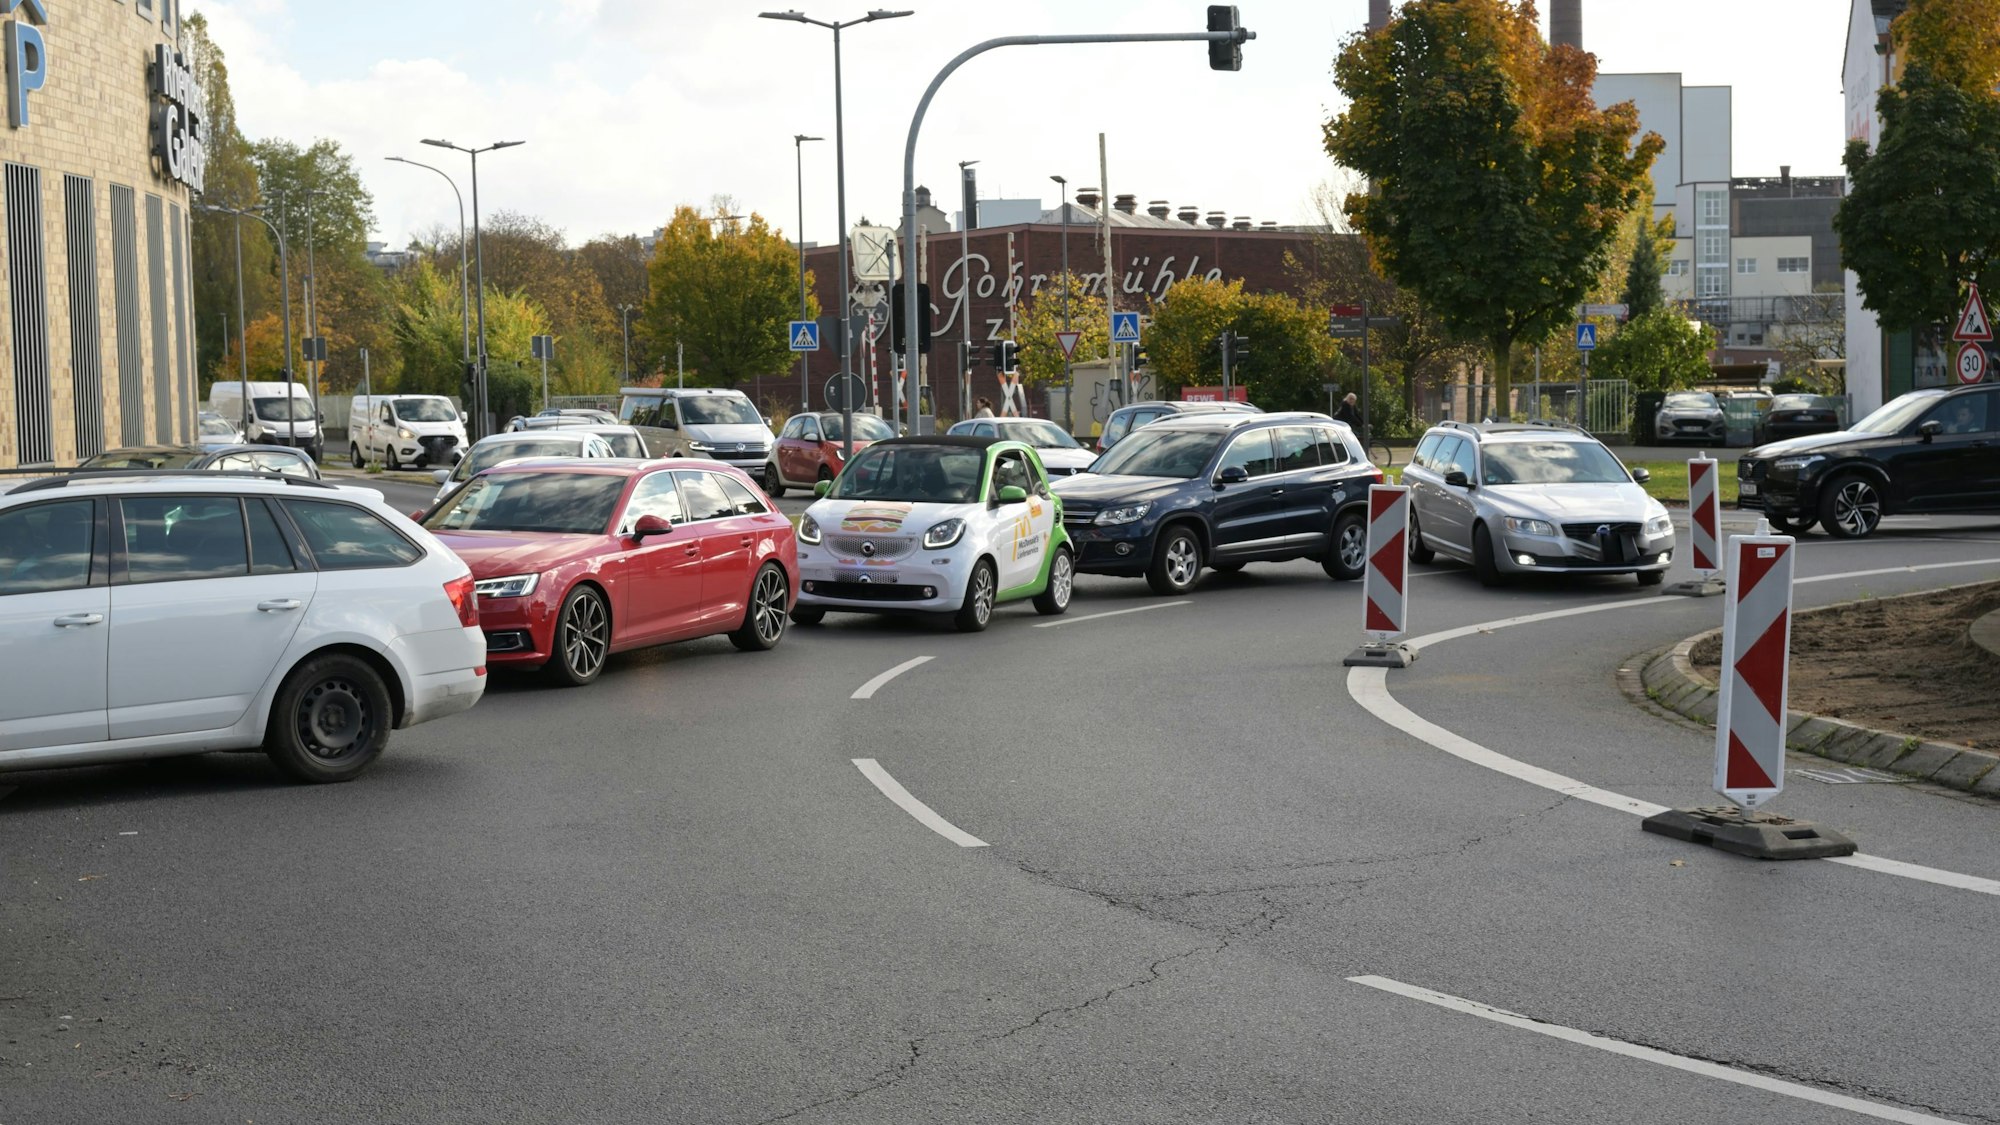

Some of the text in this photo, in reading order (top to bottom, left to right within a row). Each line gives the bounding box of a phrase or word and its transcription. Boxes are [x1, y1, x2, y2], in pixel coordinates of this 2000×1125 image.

[8, 20, 47, 129] P
[931, 253, 1222, 337] Gohrmühle
[1964, 355, 1979, 372] 30
